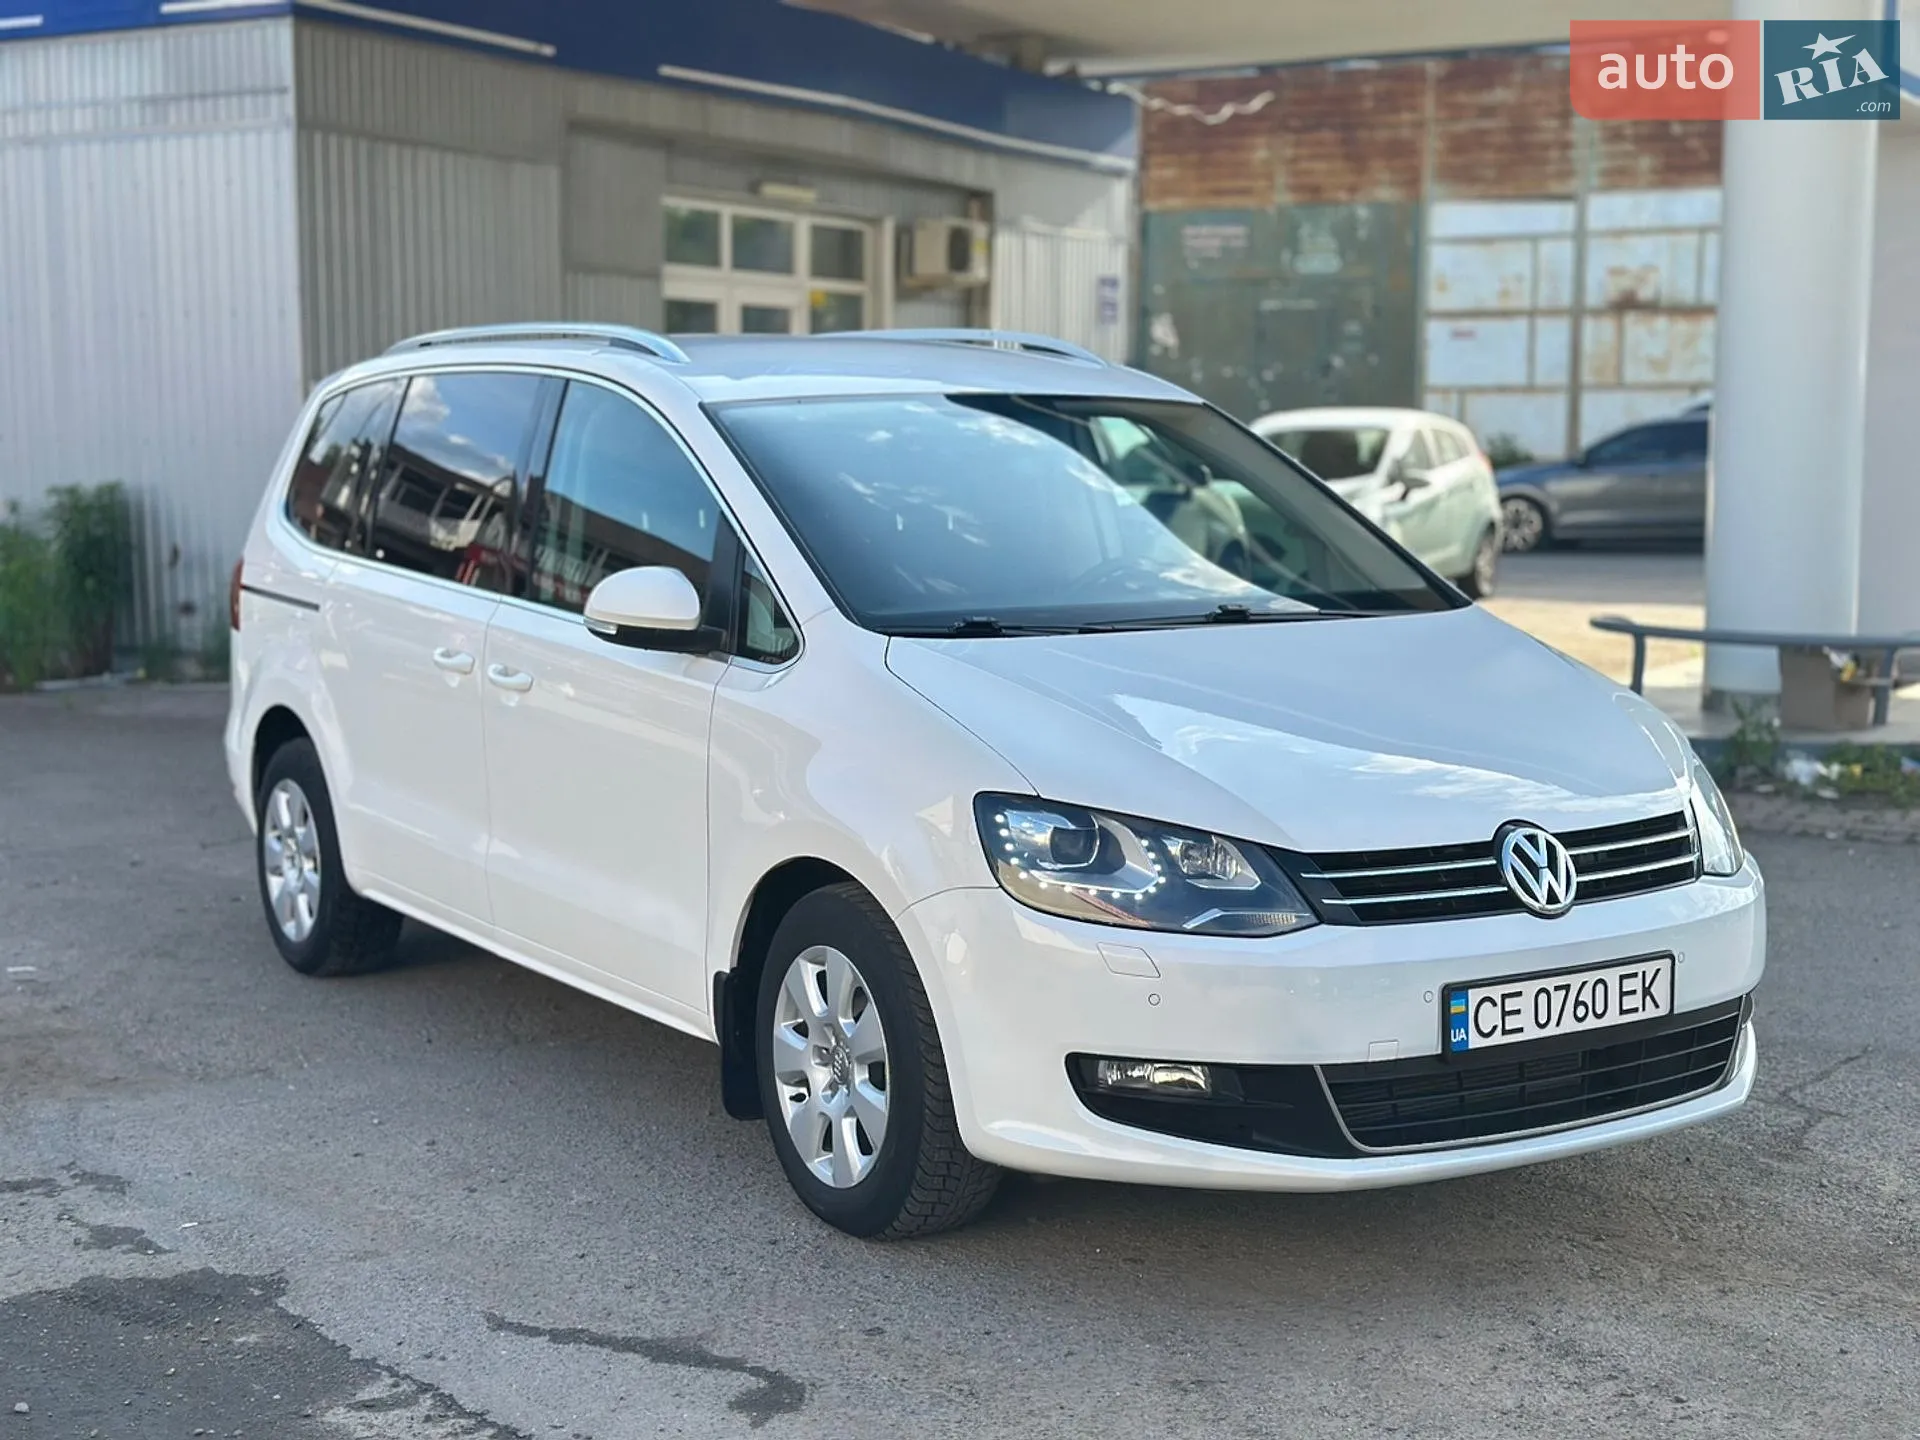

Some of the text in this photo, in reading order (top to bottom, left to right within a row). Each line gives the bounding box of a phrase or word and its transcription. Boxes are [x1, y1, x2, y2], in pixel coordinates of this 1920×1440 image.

[1473, 967, 1662, 1040] CE 0760 EK
[1450, 1028, 1467, 1043] UA
